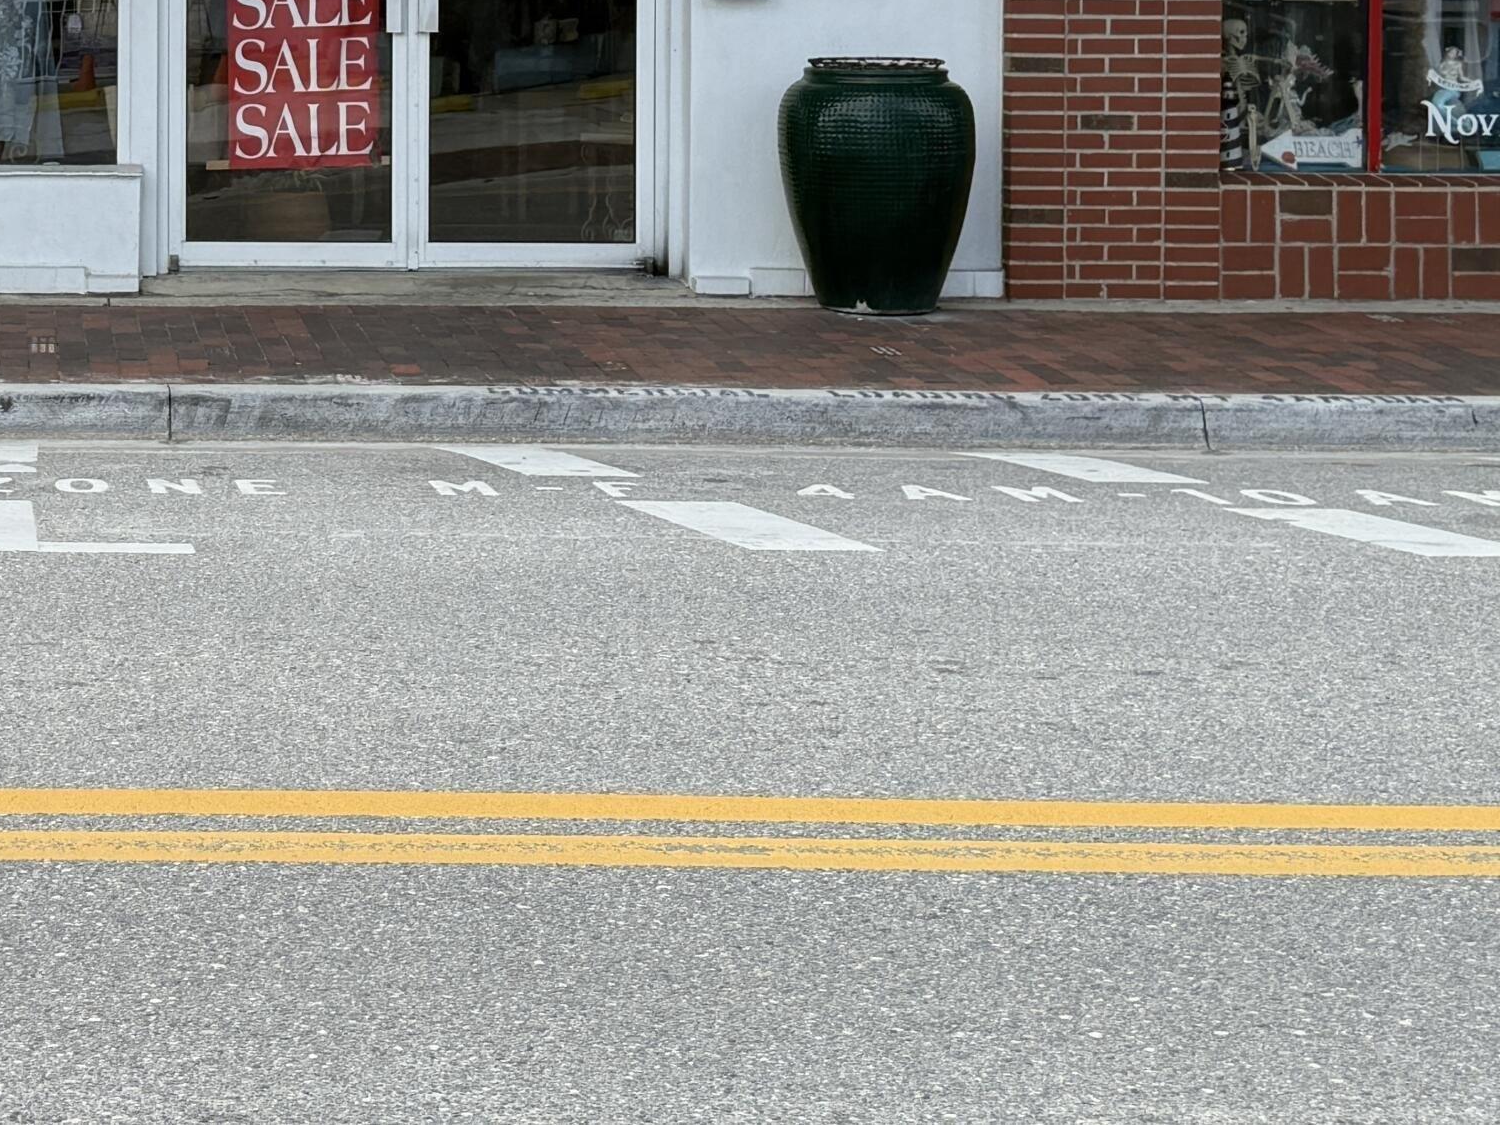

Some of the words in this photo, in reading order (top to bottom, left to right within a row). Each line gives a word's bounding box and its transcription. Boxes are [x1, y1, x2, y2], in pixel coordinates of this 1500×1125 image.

[234, 36, 373, 96] SALE
[235, 101, 374, 159] SALE
[1293, 140, 1352, 158] BEACH
